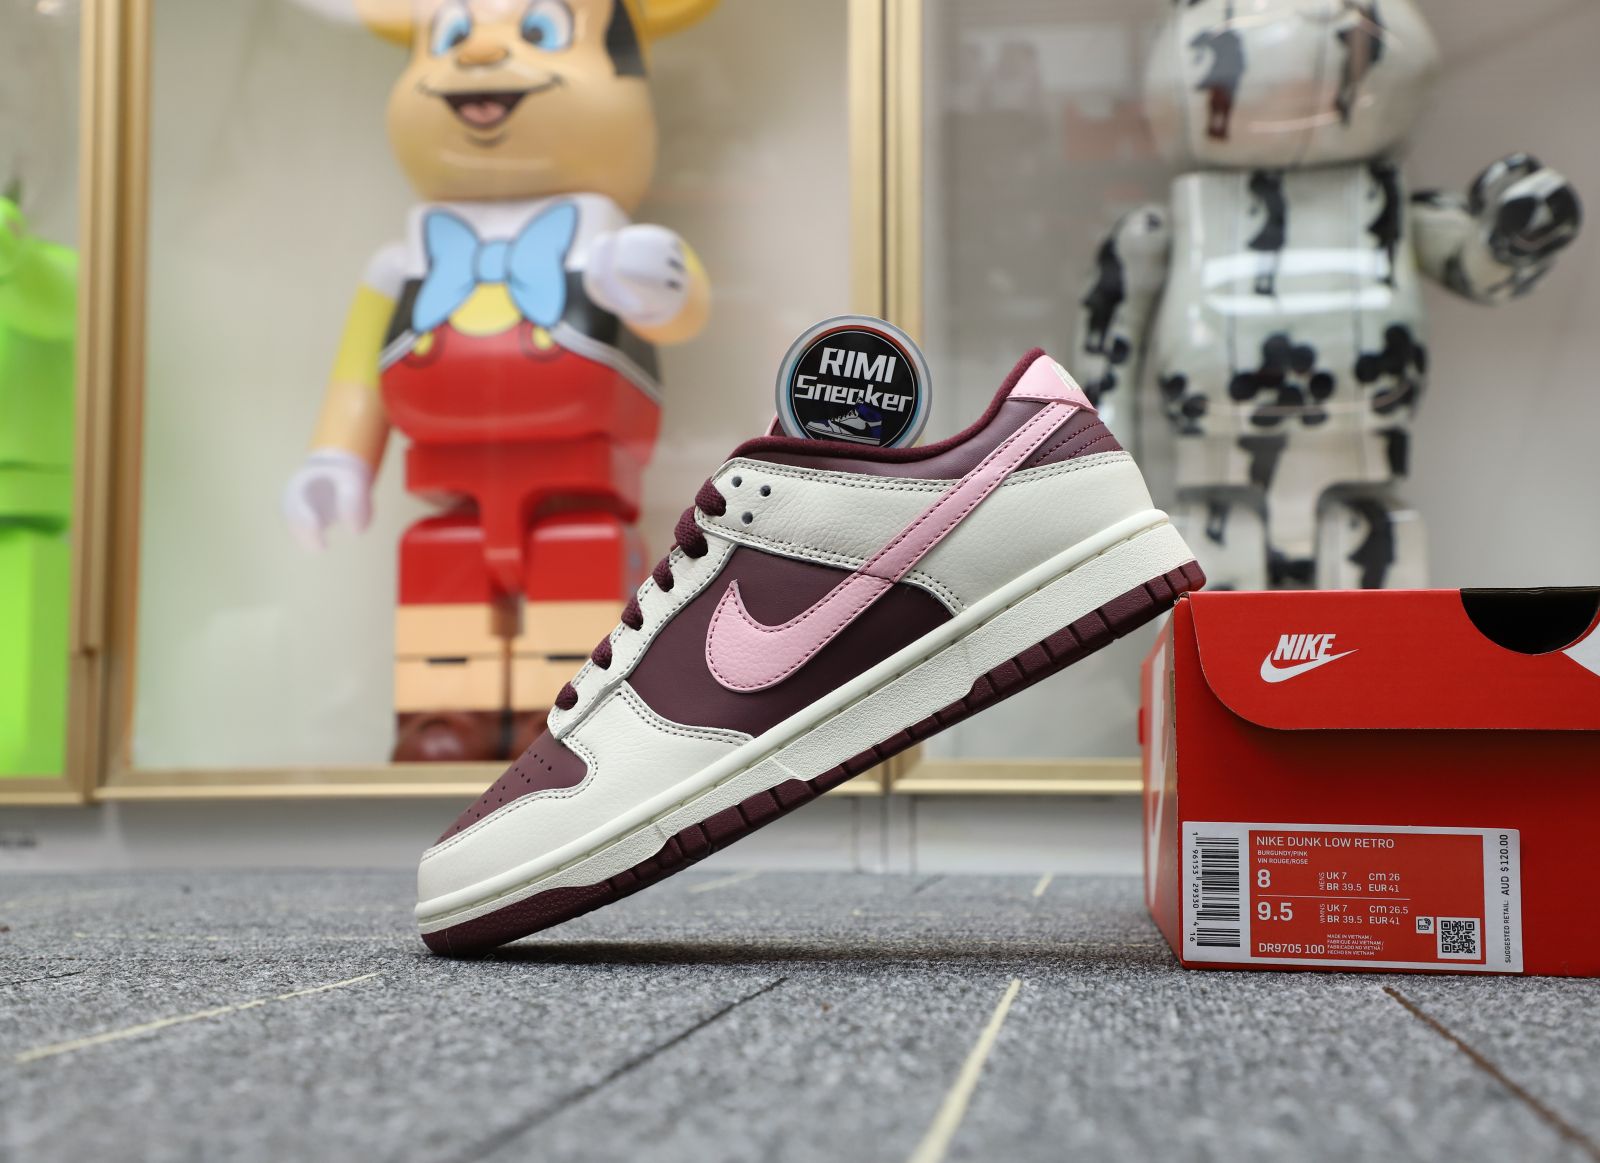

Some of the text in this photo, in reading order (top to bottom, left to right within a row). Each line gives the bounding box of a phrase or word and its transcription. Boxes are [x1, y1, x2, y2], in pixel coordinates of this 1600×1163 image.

[819, 347, 897, 383] RIMI
[794, 374, 913, 413] Sneaker
[1273, 633, 1336, 660] NIKE
[1256, 836, 1395, 849] NIKE DUNK LOW RETRO
[1257, 868, 1271, 888] 8
[1326, 872, 1348, 880] UK 7
[1368, 873, 1401, 881] cm 26
[1326, 883, 1362, 892] BR 39.5
[1368, 884, 1400, 893] EUR 41
[1501, 876, 1510, 896] AUD
[1257, 901, 1294, 922] 9.5
[1326, 904, 1348, 912] UK 7
[1369, 905, 1409, 914] cm 26.5
[1327, 915, 1363, 924] BR 39.5
[1369, 916, 1400, 925] EUR 41
[1258, 942, 1325, 954] DR9705 100
